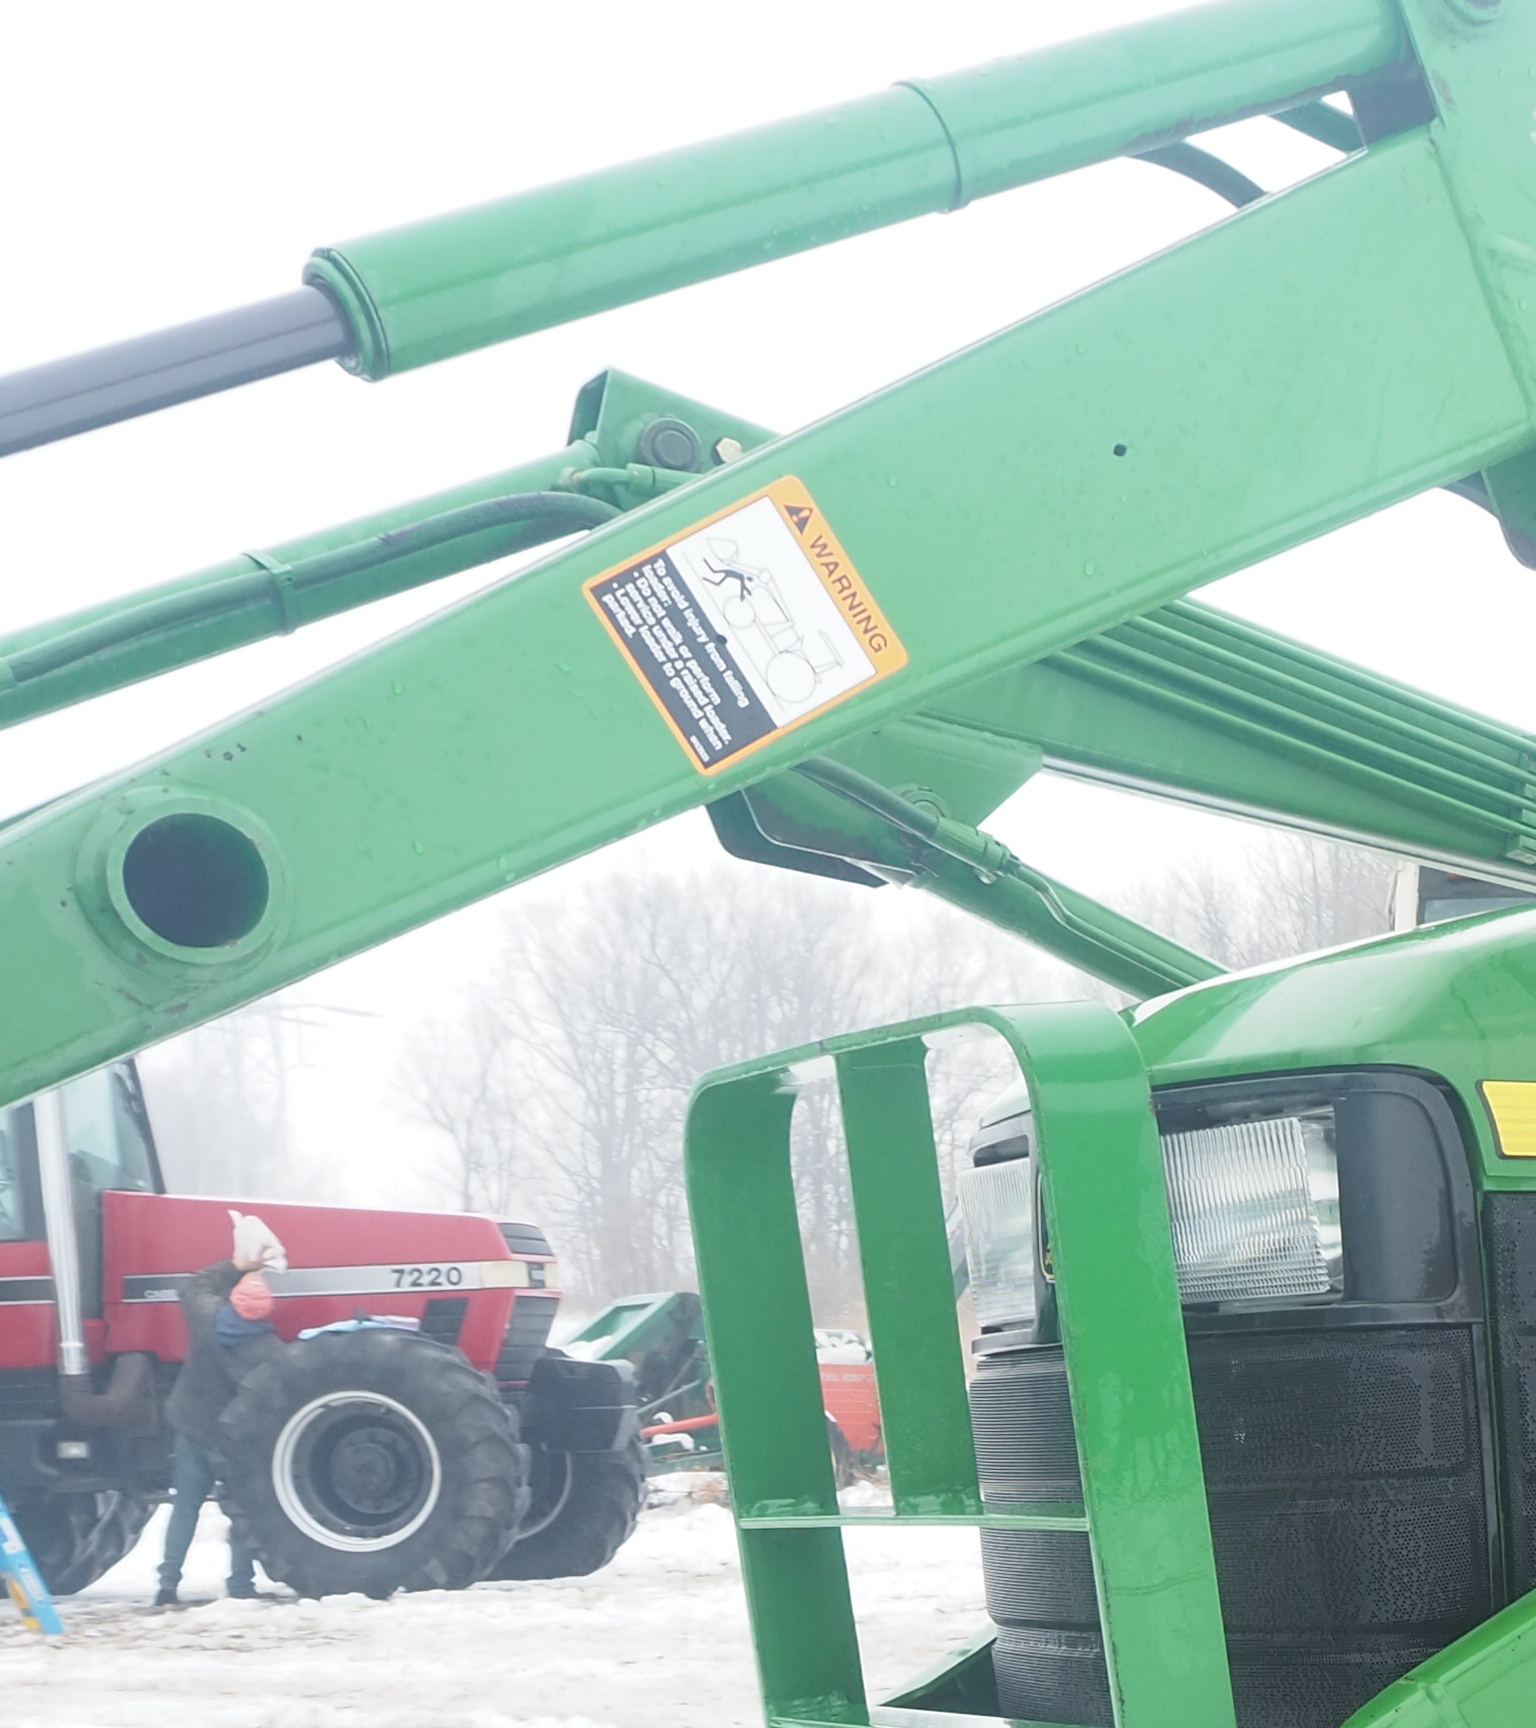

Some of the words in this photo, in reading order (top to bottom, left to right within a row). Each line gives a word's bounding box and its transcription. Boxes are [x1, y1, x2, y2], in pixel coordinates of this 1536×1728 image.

[635, 576, 656, 597] Do
[809, 534, 888, 653] WARNING
[601, 593, 637, 639] parked.
[653, 557, 667, 577] To
[661, 576, 690, 610] avoid
[682, 607, 710, 643] injury
[704, 641, 727, 672] from
[722, 669, 750, 709] falling
[661, 616, 684, 646] walk
[624, 582, 657, 626] service
[651, 624, 680, 660] under
[679, 665, 710, 707] raised
[678, 644, 693, 659] or
[614, 587, 644, 626] Lower
[638, 624, 668, 663] loader
[662, 661, 676, 678] to
[669, 676, 705, 720] ground
[698, 717, 723, 751] when
[685, 658, 721, 706] perform
[391, 1266, 463, 1288] 7220
